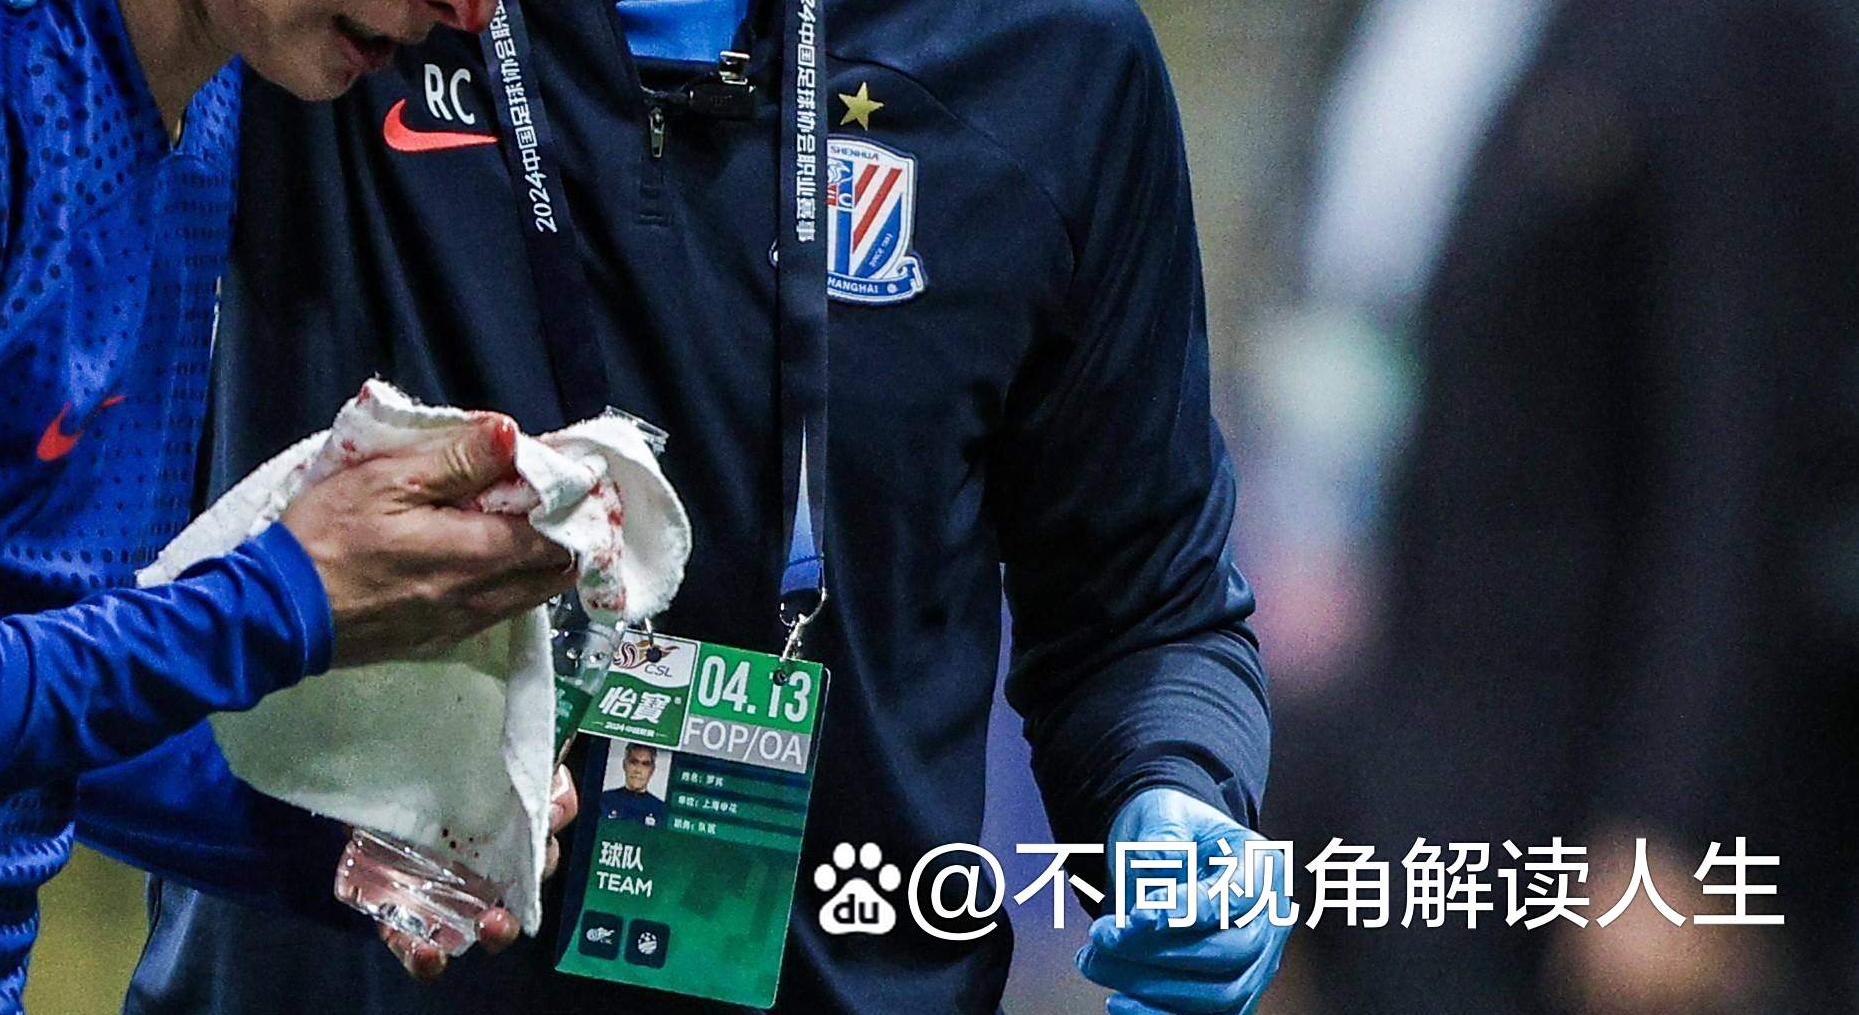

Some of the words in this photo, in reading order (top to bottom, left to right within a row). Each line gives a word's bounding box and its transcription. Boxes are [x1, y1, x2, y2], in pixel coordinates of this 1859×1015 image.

[424, 63, 476, 125] RC
[829, 144, 880, 162] SHENHUA
[827, 277, 879, 295] HANGHAI
[643, 662, 673, 678] CSL
[598, 686, 672, 724] 怡寶
[697, 655, 812, 723] 04.13
[682, 717, 804, 765] FOP/OA
[598, 840, 644, 872] 球队
[596, 871, 653, 898] TEAM
